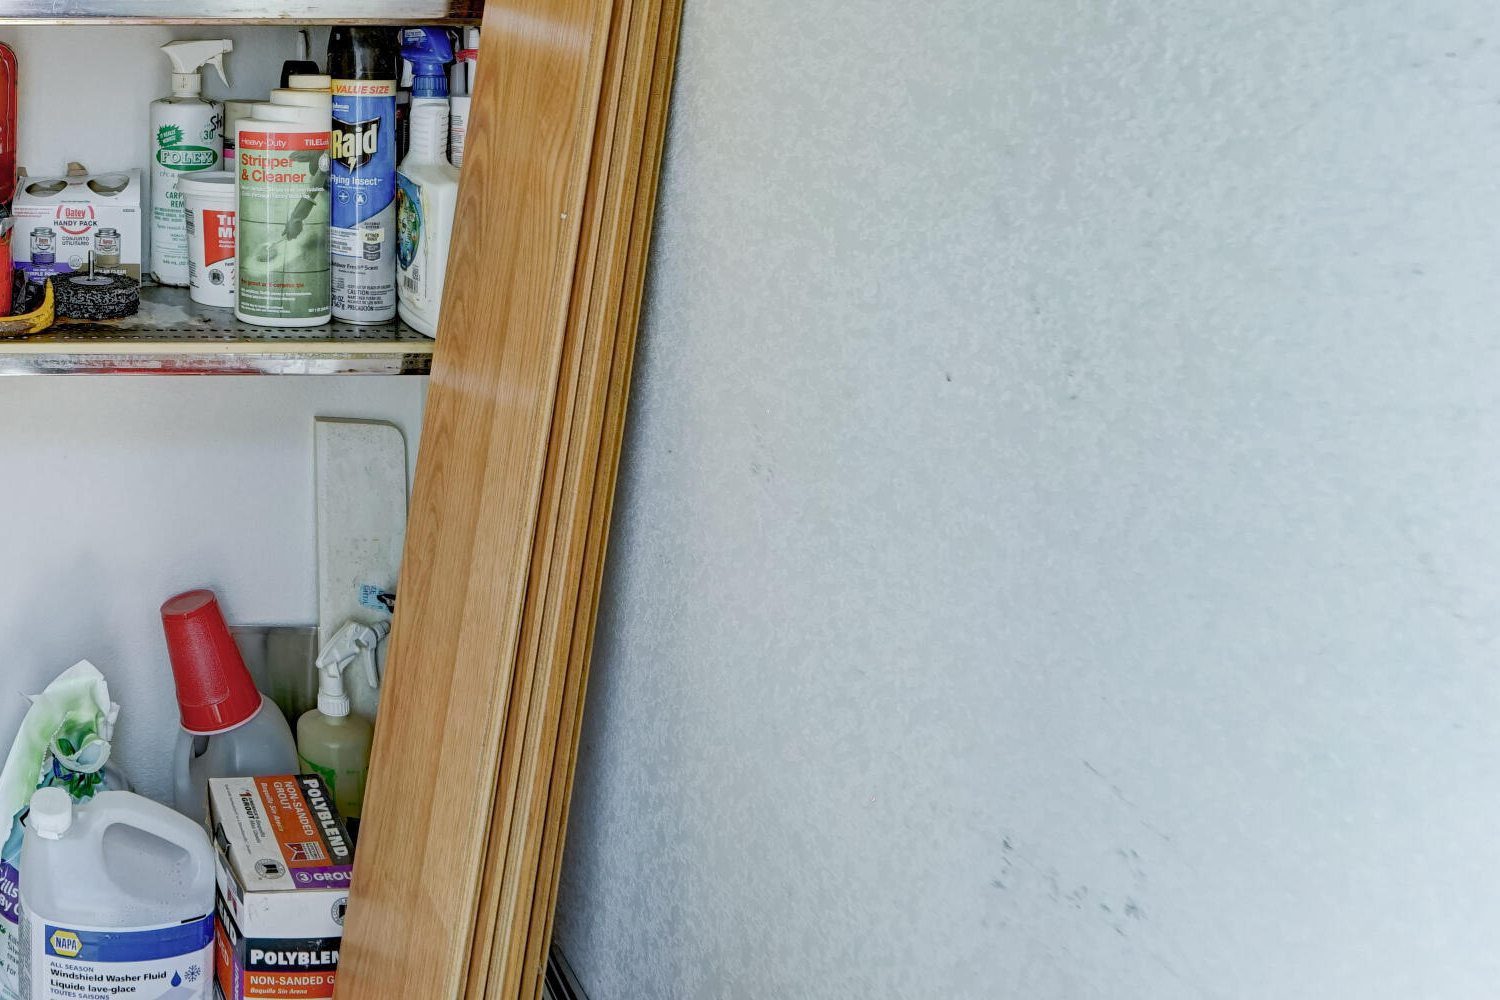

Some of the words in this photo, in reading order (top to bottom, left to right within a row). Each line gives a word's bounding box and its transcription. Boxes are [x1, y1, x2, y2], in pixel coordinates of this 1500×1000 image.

[336, 85, 369, 94] VALUE
[370, 86, 389, 94] SIZE
[242, 138, 287, 148] Heavy-Duty
[333, 123, 378, 160] Raid
[161, 151, 213, 164] FOLEX
[241, 153, 296, 170] Stripper
[241, 168, 249, 181] &
[251, 169, 307, 183] Cleaner
[352, 176, 378, 186] Insect
[65, 207, 86, 219] Oatey
[273, 781, 293, 810] GROUT
[241, 797, 255, 820] GROUT
[284, 781, 314, 836] NON-SANDED
[303, 779, 349, 858] POLYBLEND
[0, 893, 12, 912] By
[55, 936, 78, 951] NAPA
[51, 961, 62, 969] ALL
[64, 964, 94, 973] SEASON
[50, 968, 104, 982] Windshield
[106, 973, 141, 982] Washer
[143, 971, 167, 981] Fluid
[250, 975, 324, 985] NON-SANDED
[50, 980, 86, 992] Liquide
[88, 984, 136, 994] lave-glace
[50, 988, 77, 998] TOUTES
[78, 992, 110, 1000] SAISONS
[277, 987, 288, 995] Sin
